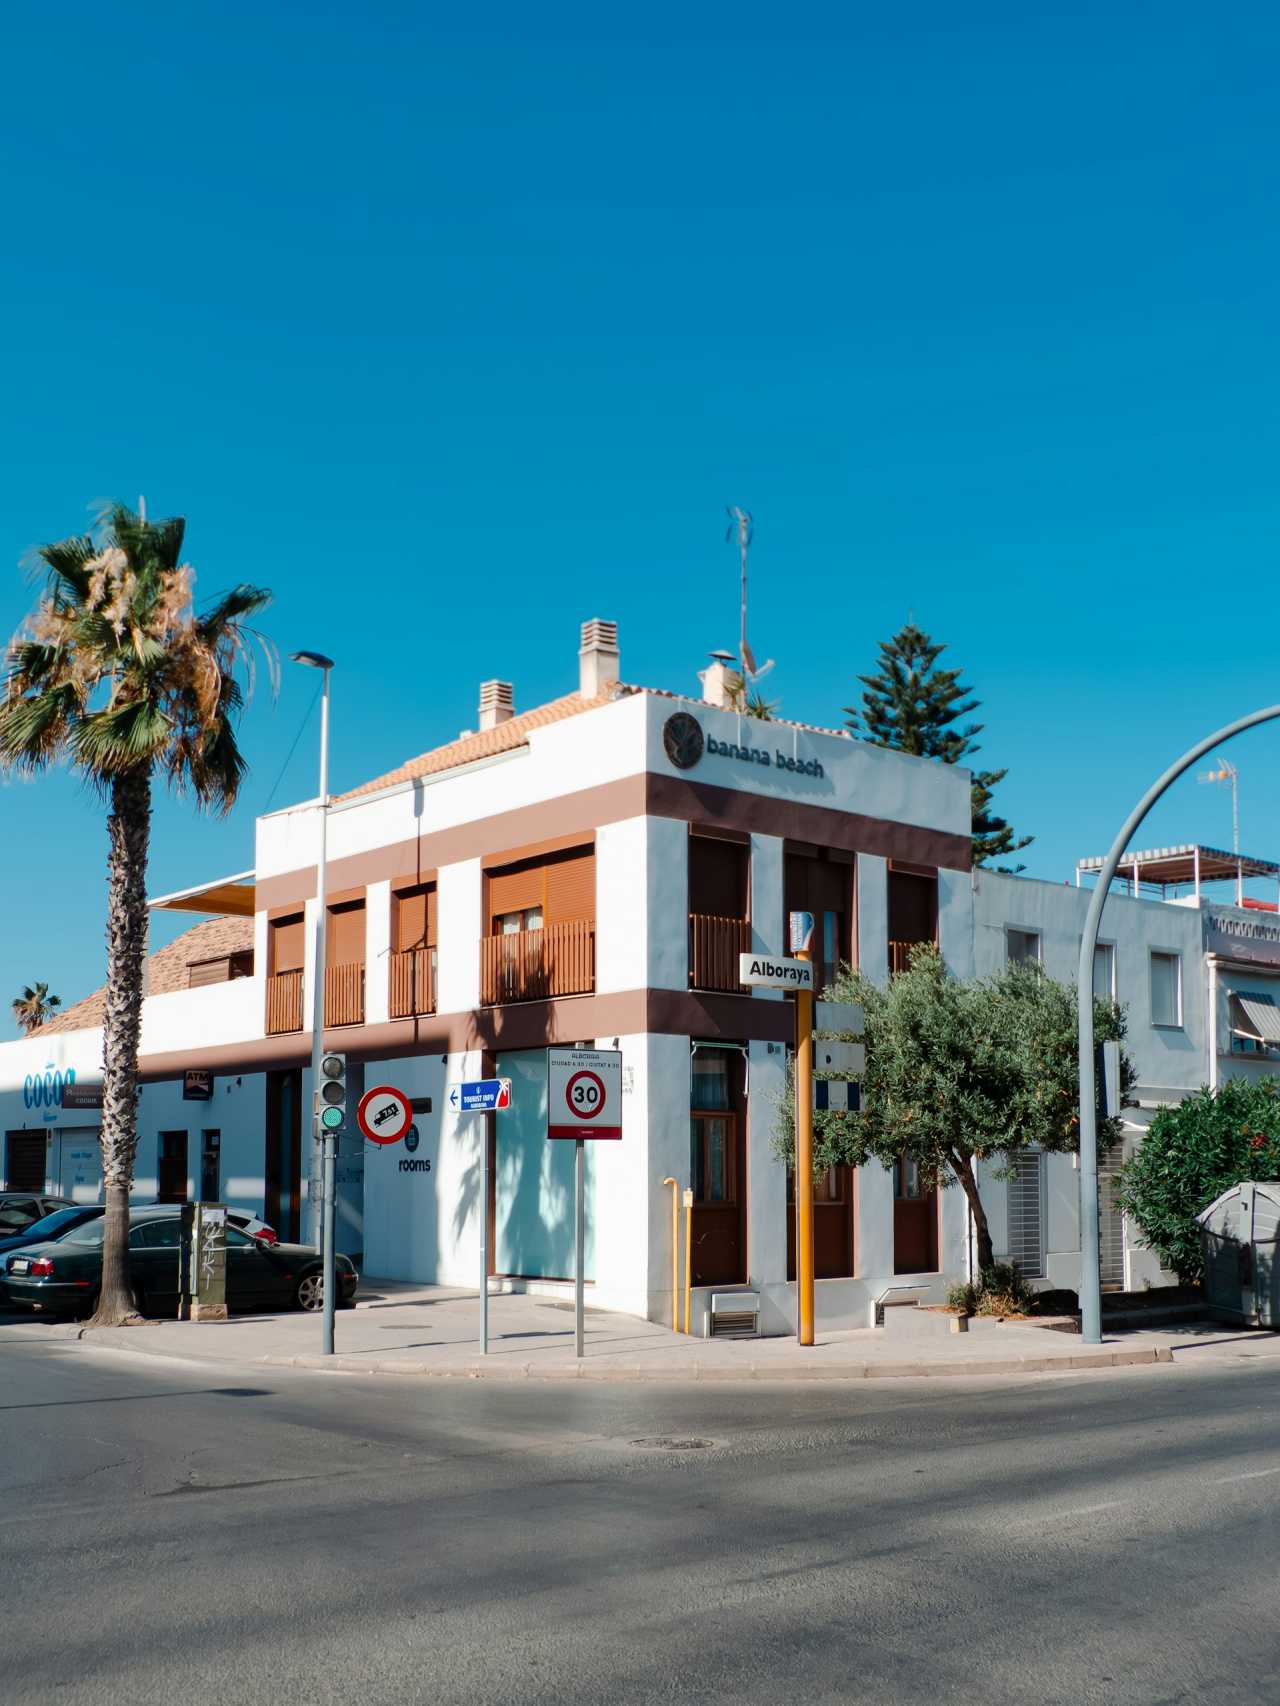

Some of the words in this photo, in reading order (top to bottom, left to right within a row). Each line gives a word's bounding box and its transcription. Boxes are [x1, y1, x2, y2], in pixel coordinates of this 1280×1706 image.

[706, 733, 771, 767] banana
[776, 748, 825, 779] beach
[749, 960, 810, 985] Alboraya
[187, 1072, 208, 1081] ATM
[463, 1095, 482, 1104] TOURIST
[482, 1094, 495, 1102] INFO
[574, 1086, 598, 1104] 30
[399, 1159, 431, 1173] rooms
